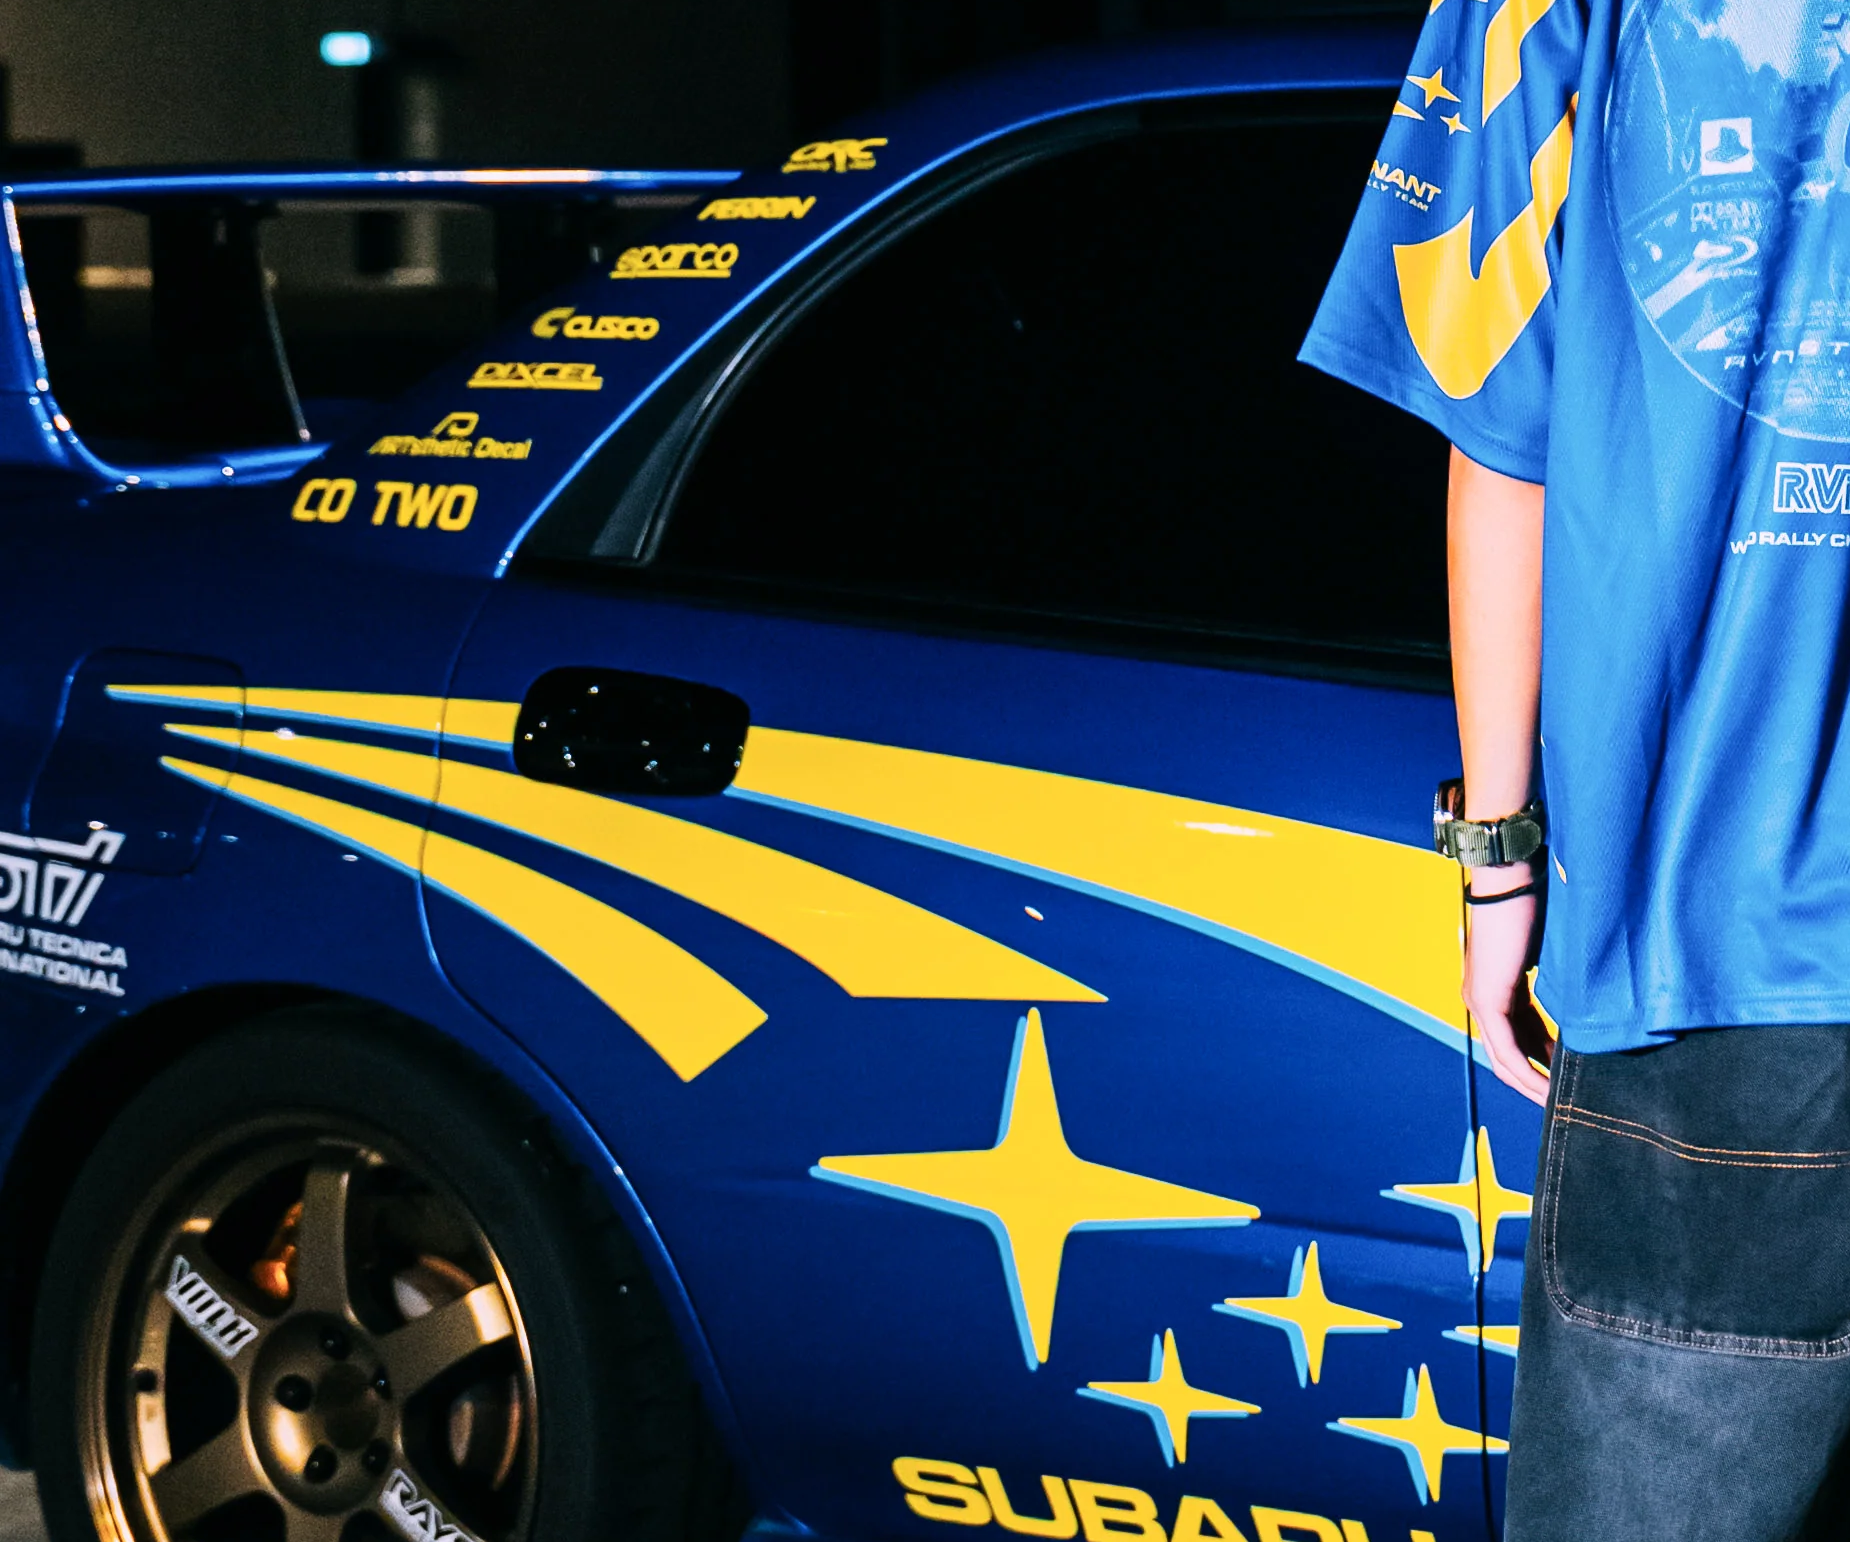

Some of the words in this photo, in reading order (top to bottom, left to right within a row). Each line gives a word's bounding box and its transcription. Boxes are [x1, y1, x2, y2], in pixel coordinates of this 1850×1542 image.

[1370, 160, 1442, 203] NANT
[291, 478, 358, 523] CO
[371, 481, 478, 531] TWO
[1759, 531, 1827, 546] RALLY
[0, 948, 126, 997] NATIONAL
